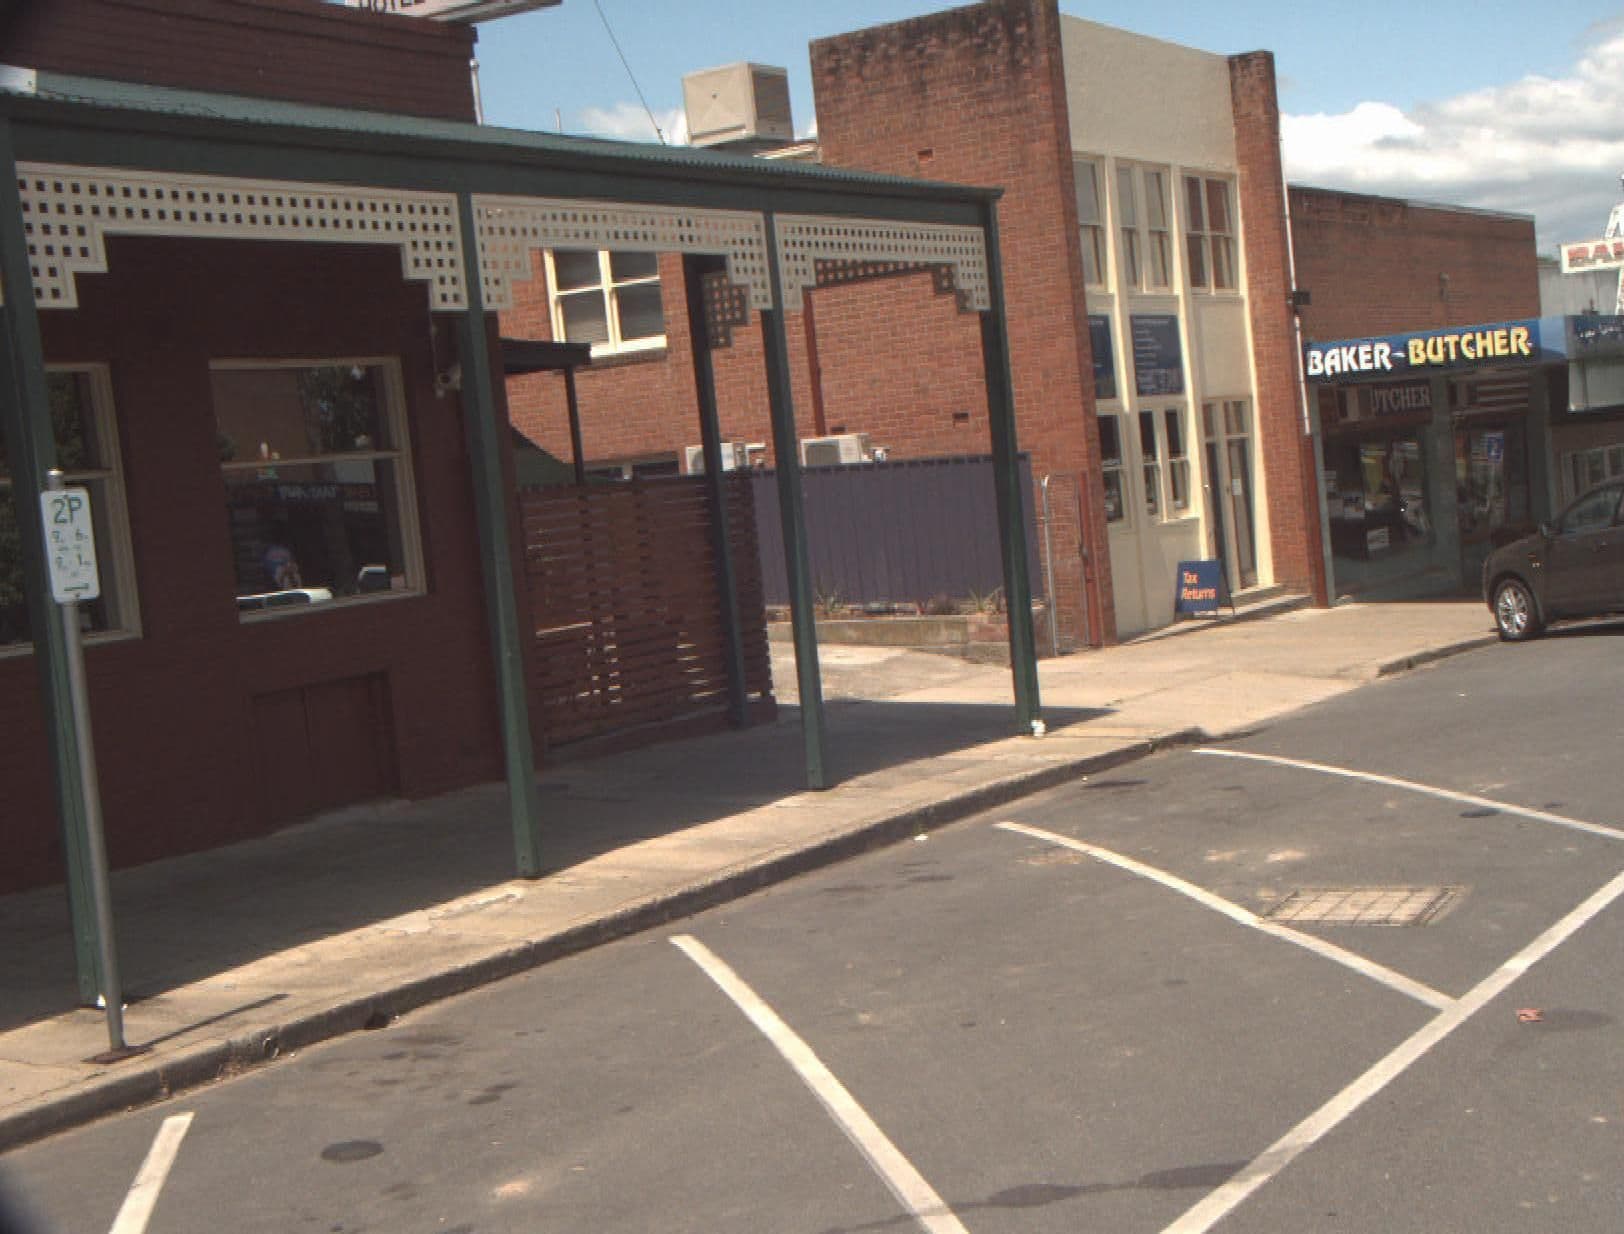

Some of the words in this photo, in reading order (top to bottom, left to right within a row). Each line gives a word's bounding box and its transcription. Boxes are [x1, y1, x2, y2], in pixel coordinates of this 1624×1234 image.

[1307, 343, 1393, 376] BAKER
[1407, 327, 1531, 365] BUTCHER
[52, 496, 82, 523] 2P
[1184, 571, 1199, 584] Tax
